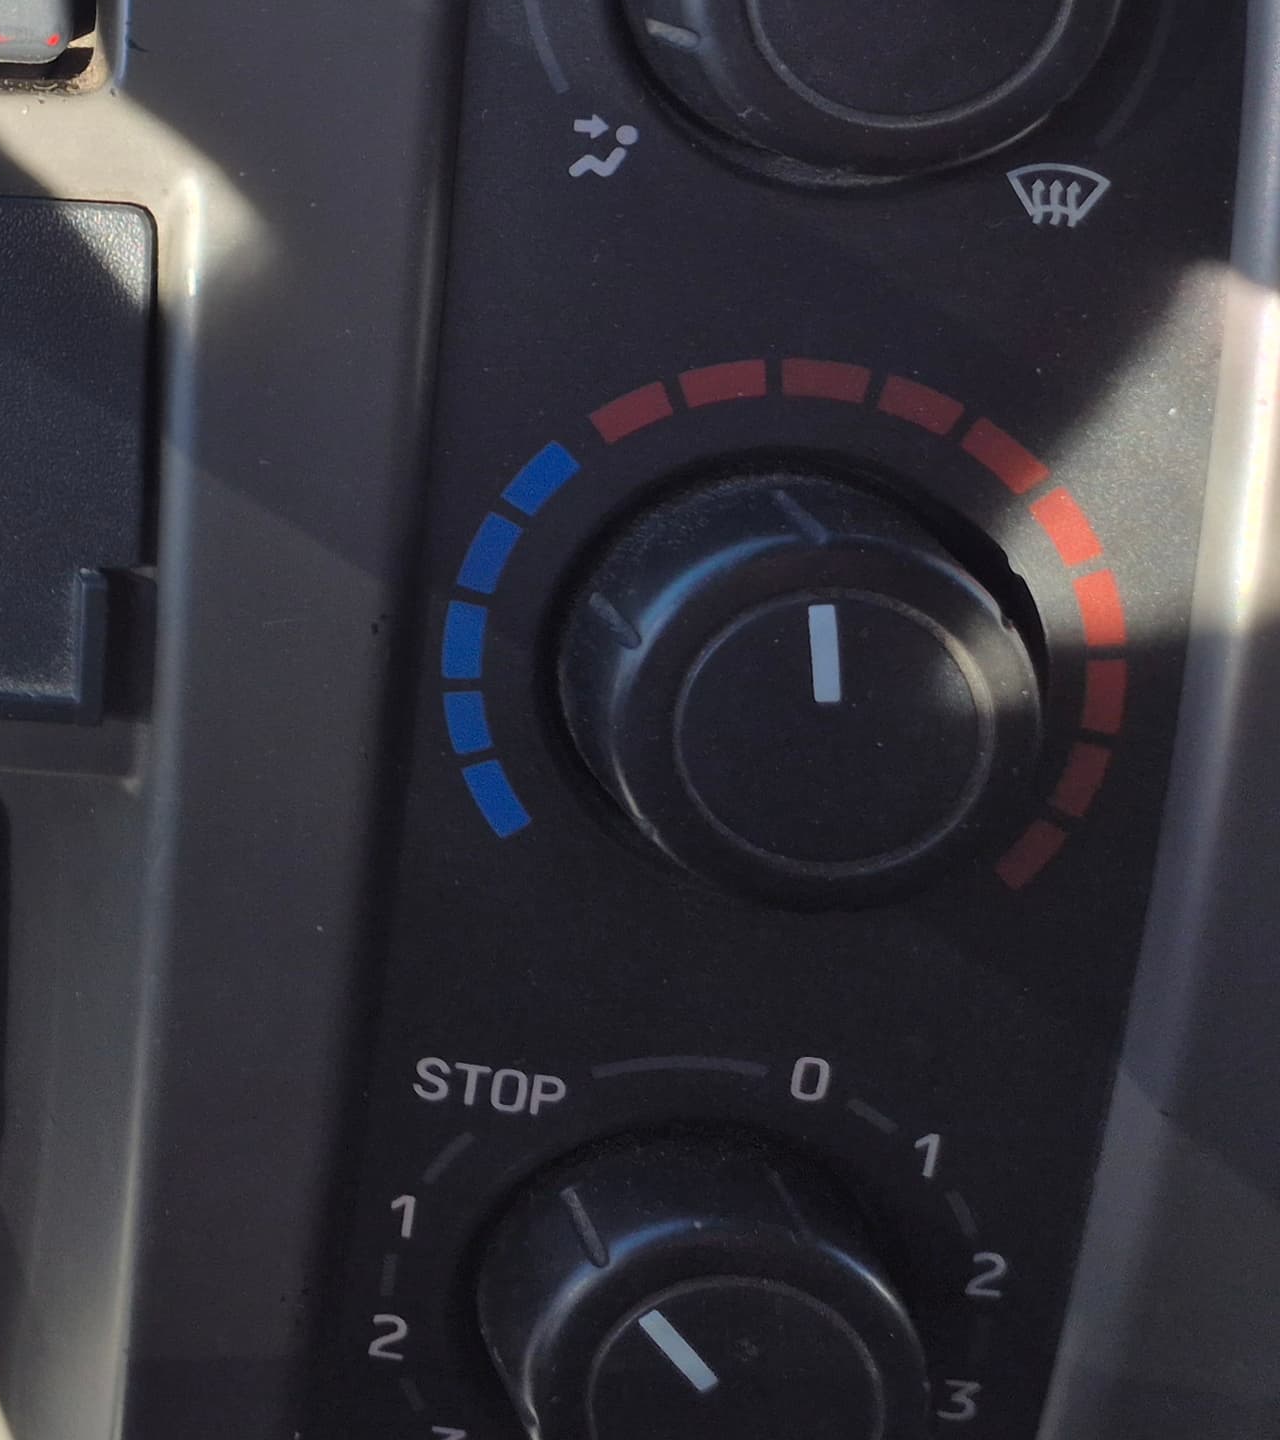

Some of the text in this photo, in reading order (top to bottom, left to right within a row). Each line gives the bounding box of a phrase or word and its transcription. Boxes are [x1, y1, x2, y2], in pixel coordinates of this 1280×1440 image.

[413, 1057, 567, 1116] STOP
[915, 1133, 941, 1178] 1
[391, 1195, 416, 1238] 1
[966, 1253, 1007, 1297] 2
[368, 1315, 408, 1360] 2
[939, 1380, 981, 1421] 3
